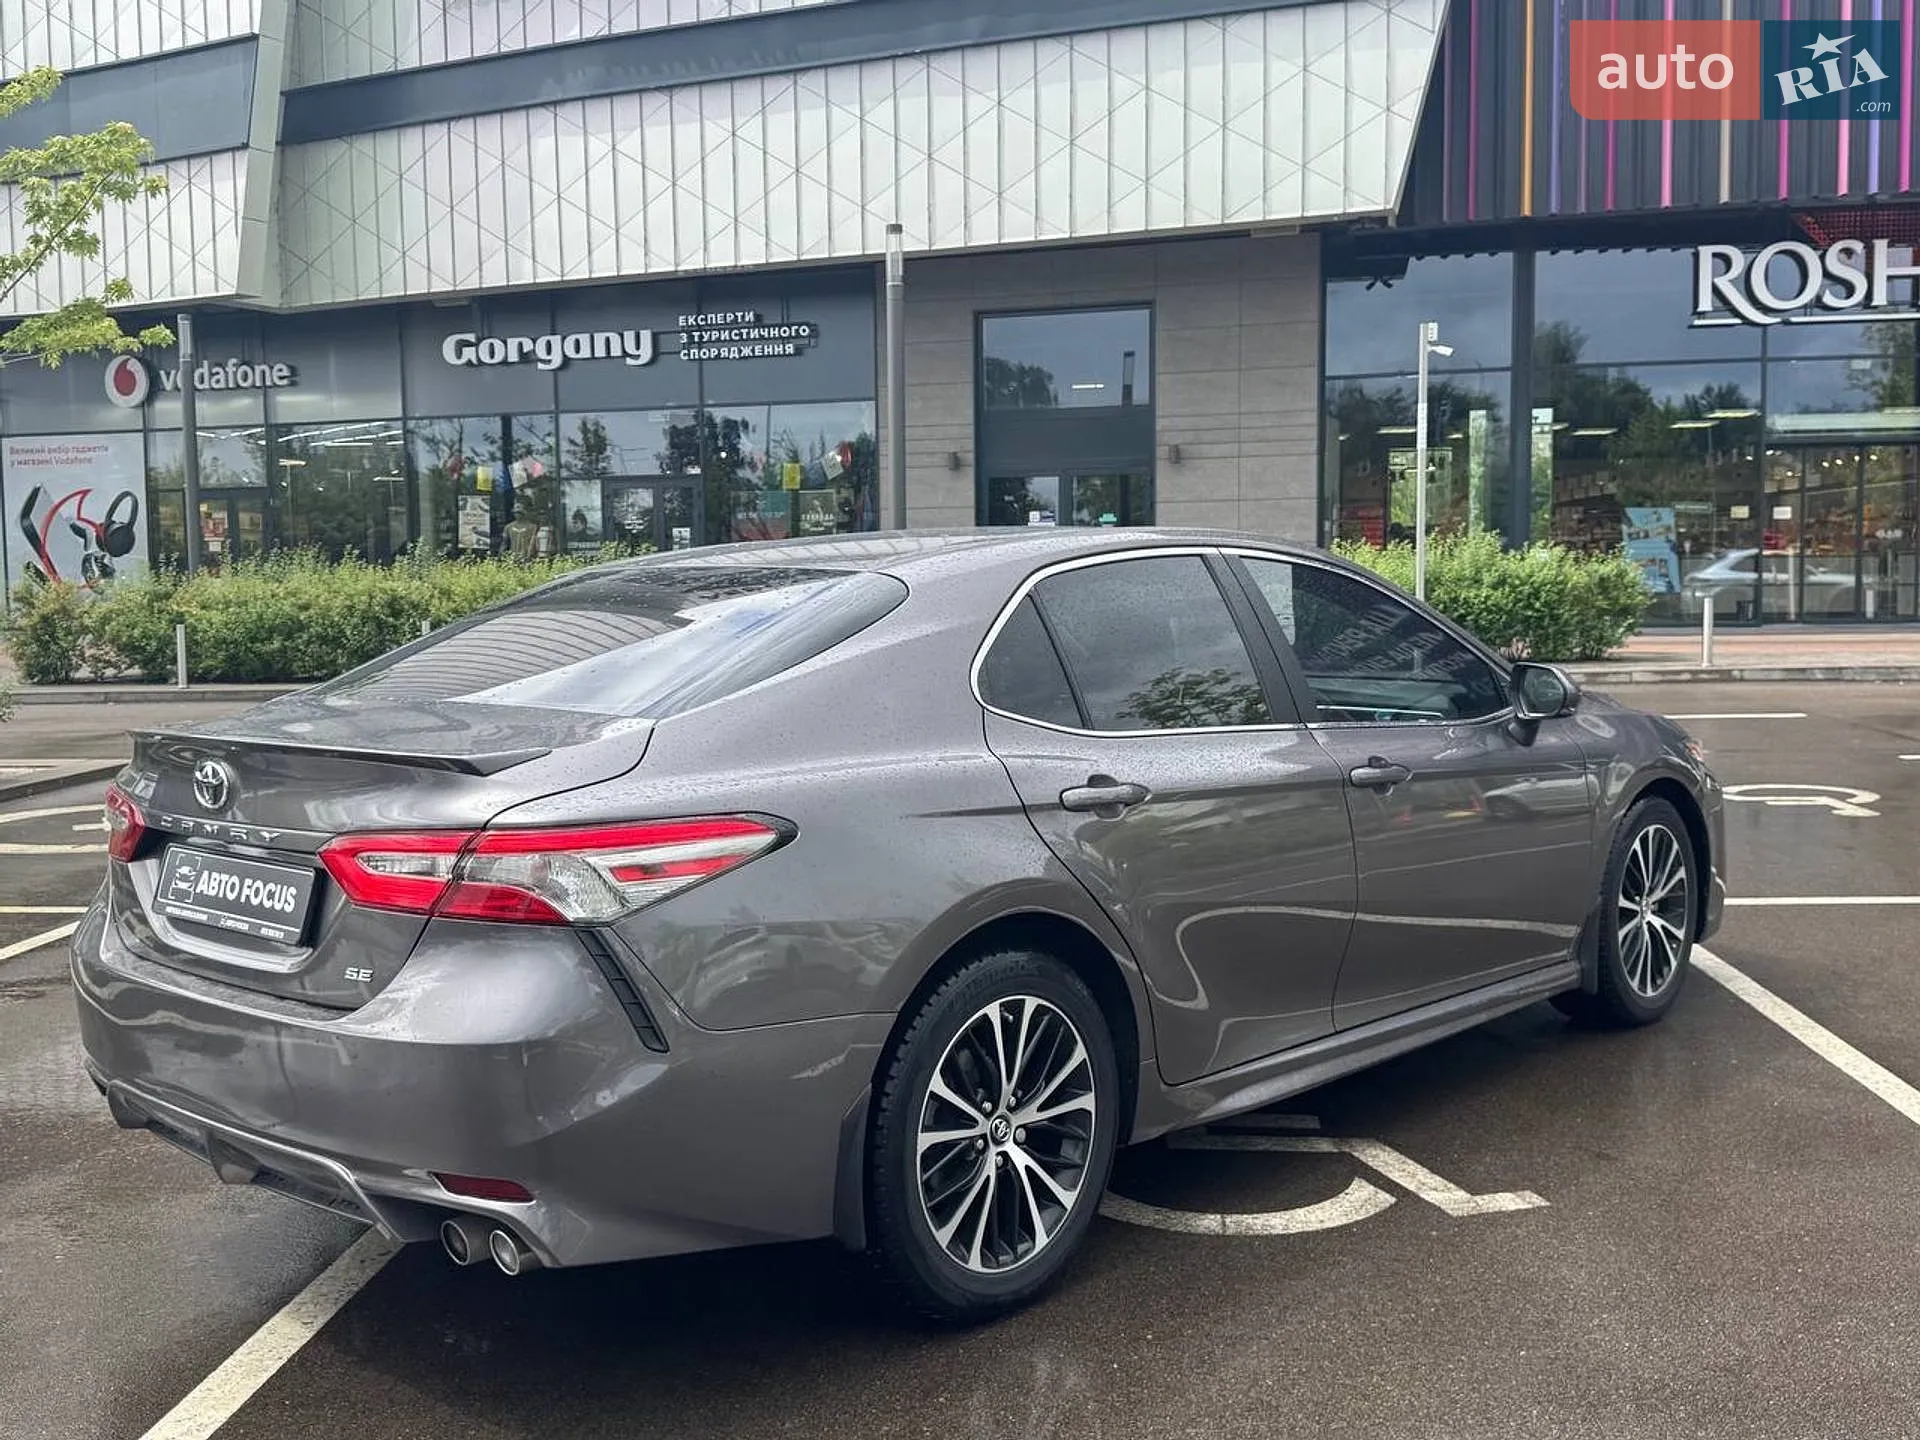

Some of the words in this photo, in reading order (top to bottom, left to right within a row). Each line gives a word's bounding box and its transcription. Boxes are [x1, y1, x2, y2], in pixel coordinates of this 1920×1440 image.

[1696, 238, 1920, 325] ROSH
[677, 310, 755, 327] ЕКСПЕРТИ
[679, 332, 688, 344] З
[691, 325, 810, 342] ТУРИСТИЧНОГО
[442, 329, 653, 371] Gorgany
[679, 343, 795, 360] СПОРЯДЖЕННЯ
[159, 358, 291, 391] vdafone
[196, 869, 240, 901] АВТО
[240, 878, 297, 914] FOCUS
[344, 967, 373, 983] SE
